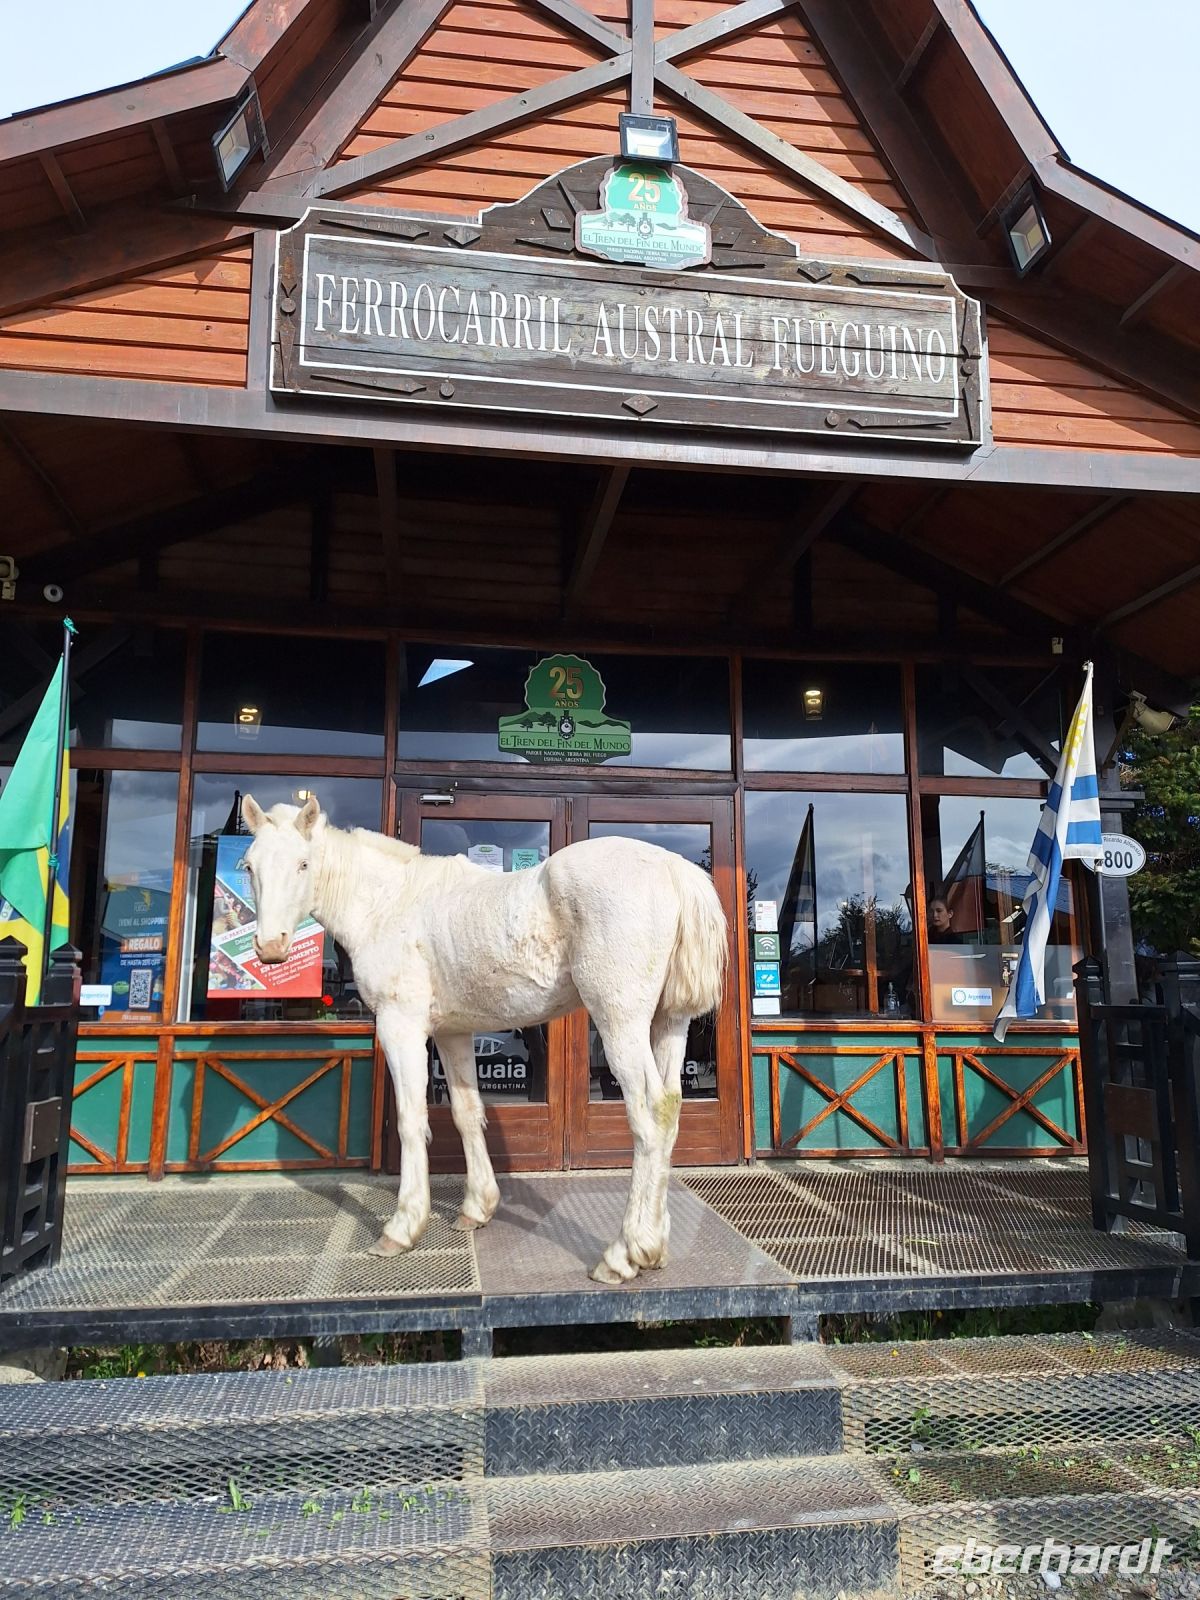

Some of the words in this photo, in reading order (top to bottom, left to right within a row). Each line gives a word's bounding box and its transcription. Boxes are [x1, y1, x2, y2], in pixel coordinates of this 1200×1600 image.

[628, 172, 661, 203] 25
[633, 201, 657, 212] AÑOS
[583, 233, 593, 242] EL
[592, 232, 616, 244] TREN
[617, 236, 635, 246] DEL
[636, 237, 651, 249] FIN
[652, 241, 670, 250] DEL
[314, 273, 573, 353] FERROCARRIL
[591, 300, 754, 368] AUSTRAL
[771, 316, 946, 383] FUEGUINO
[549, 666, 584, 699] 25
[555, 698, 579, 708] AÑOS
[500, 738, 511, 746] EL
[510, 735, 535, 747] TREN
[537, 738, 554, 747] DEL
[557, 738, 573, 749] FIN
[574, 740, 592, 749] DEL
[593, 738, 630, 750] MUNDO
[1104, 850, 1133, 869] 800
[128, 937, 160, 951] REGALO
[282, 946, 319, 966] OMENTO
[968, 993, 991, 1001] Argentina
[433, 1058, 527, 1079] Uuaia
